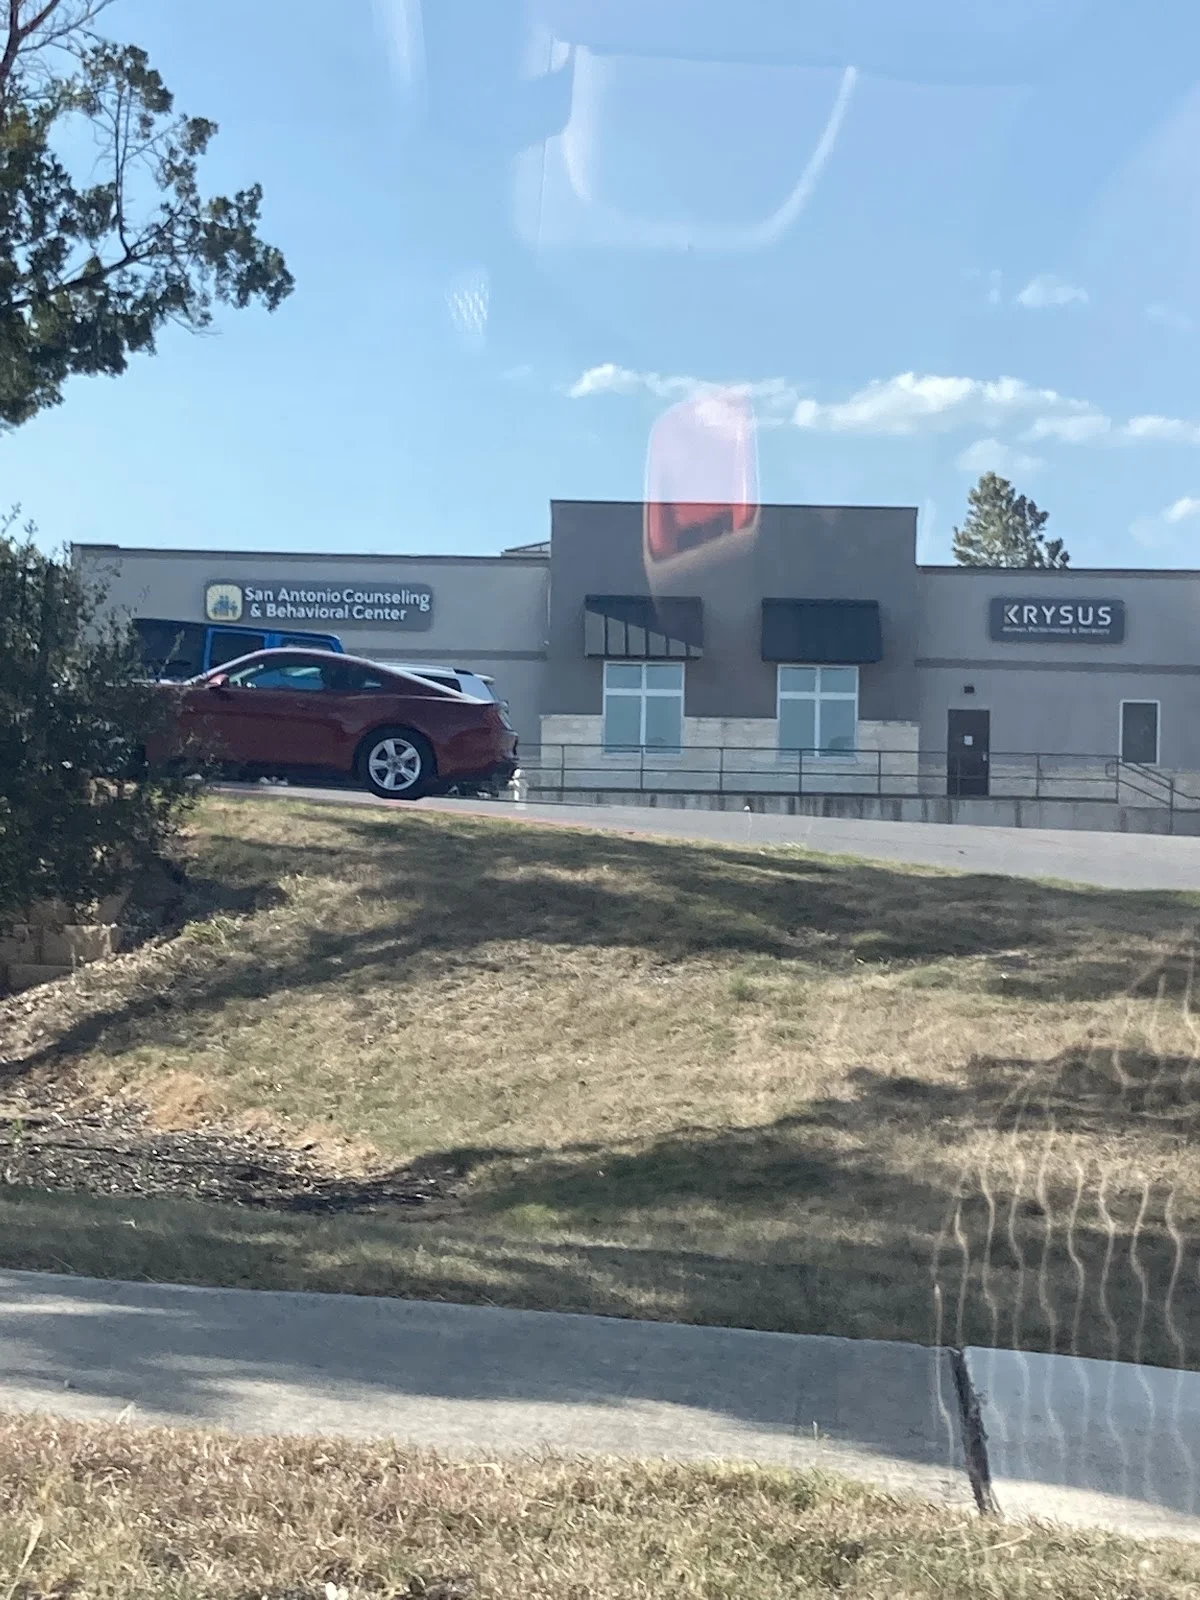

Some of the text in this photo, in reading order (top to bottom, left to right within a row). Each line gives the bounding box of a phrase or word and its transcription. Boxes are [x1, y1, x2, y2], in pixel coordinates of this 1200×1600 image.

[244, 587, 431, 612] San Antonio Counseling
[250, 603, 408, 621] & Behavioral Center
[1004, 605, 1112, 626] KRYSUS
